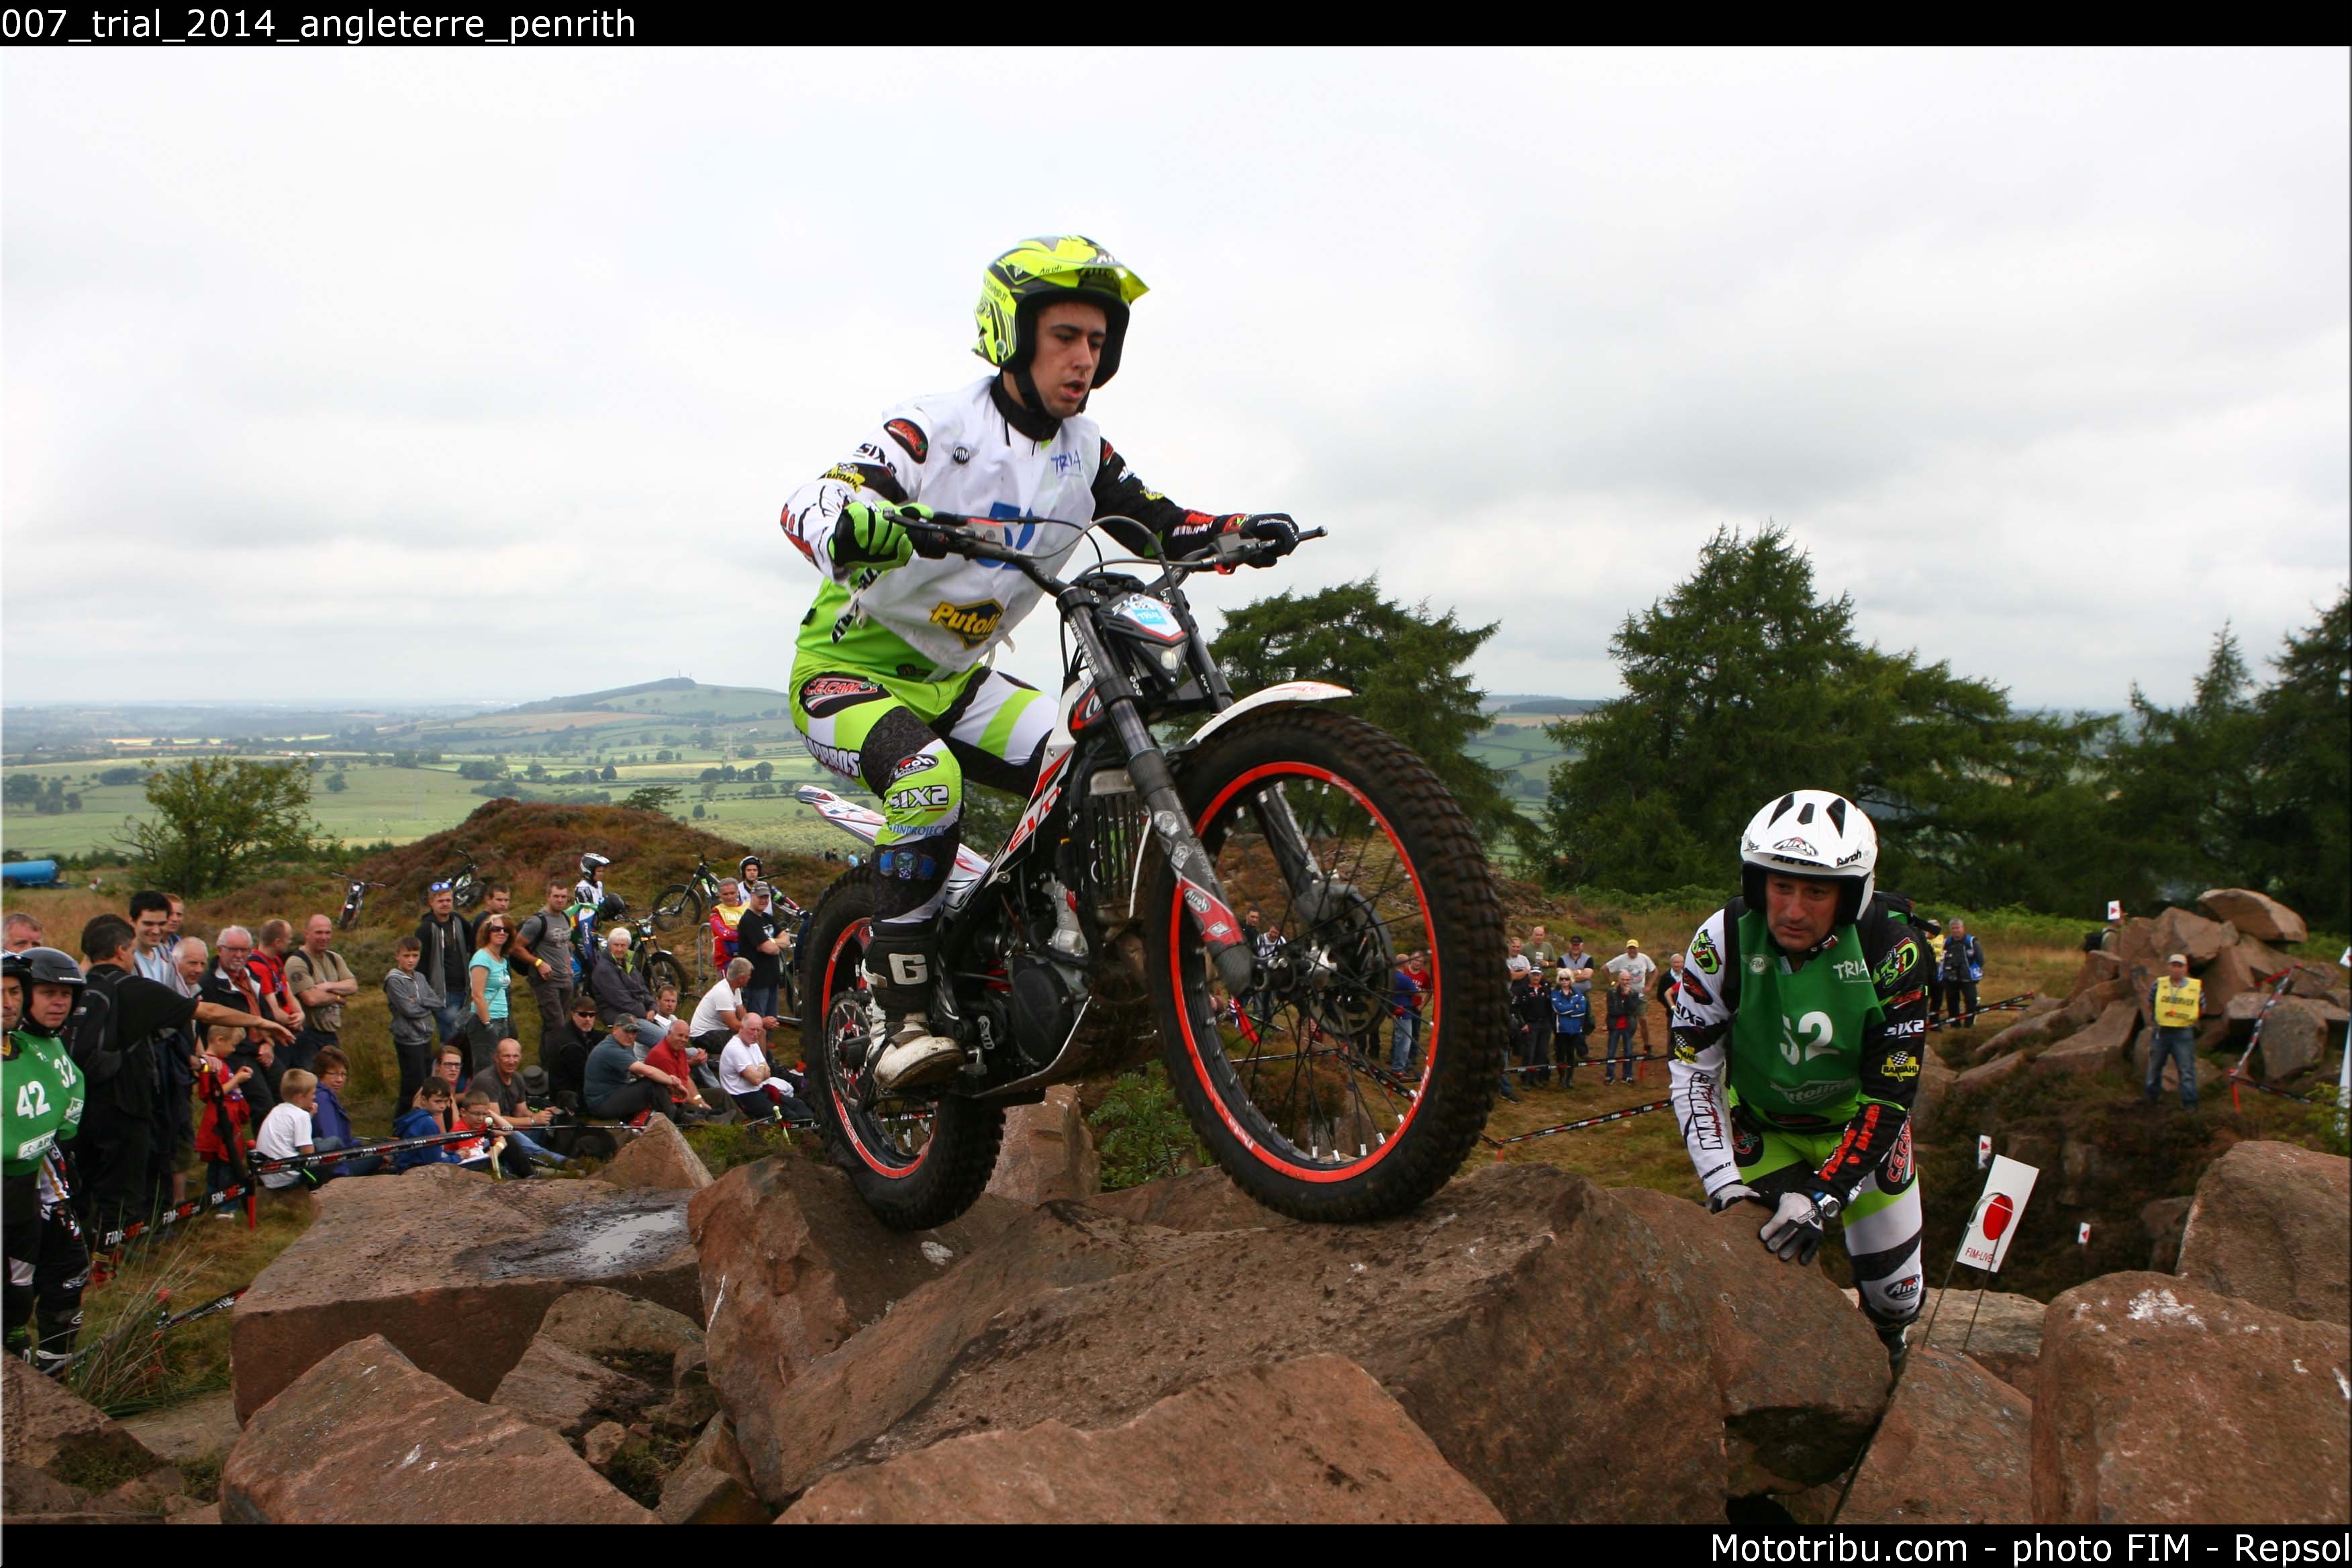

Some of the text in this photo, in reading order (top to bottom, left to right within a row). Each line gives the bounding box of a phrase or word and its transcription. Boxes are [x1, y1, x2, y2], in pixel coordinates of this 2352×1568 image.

[1050, 449, 1083, 475] TRIA
[930, 601, 1001, 634] Putoli
[888, 785, 950, 809] SIX2
[1836, 848, 1863, 867] Airoh
[1832, 959, 1871, 980] TRIA
[1884, 1020, 1924, 1036] SIX2
[54, 1055, 77, 1089] 32
[16, 1080, 52, 1120] 42
